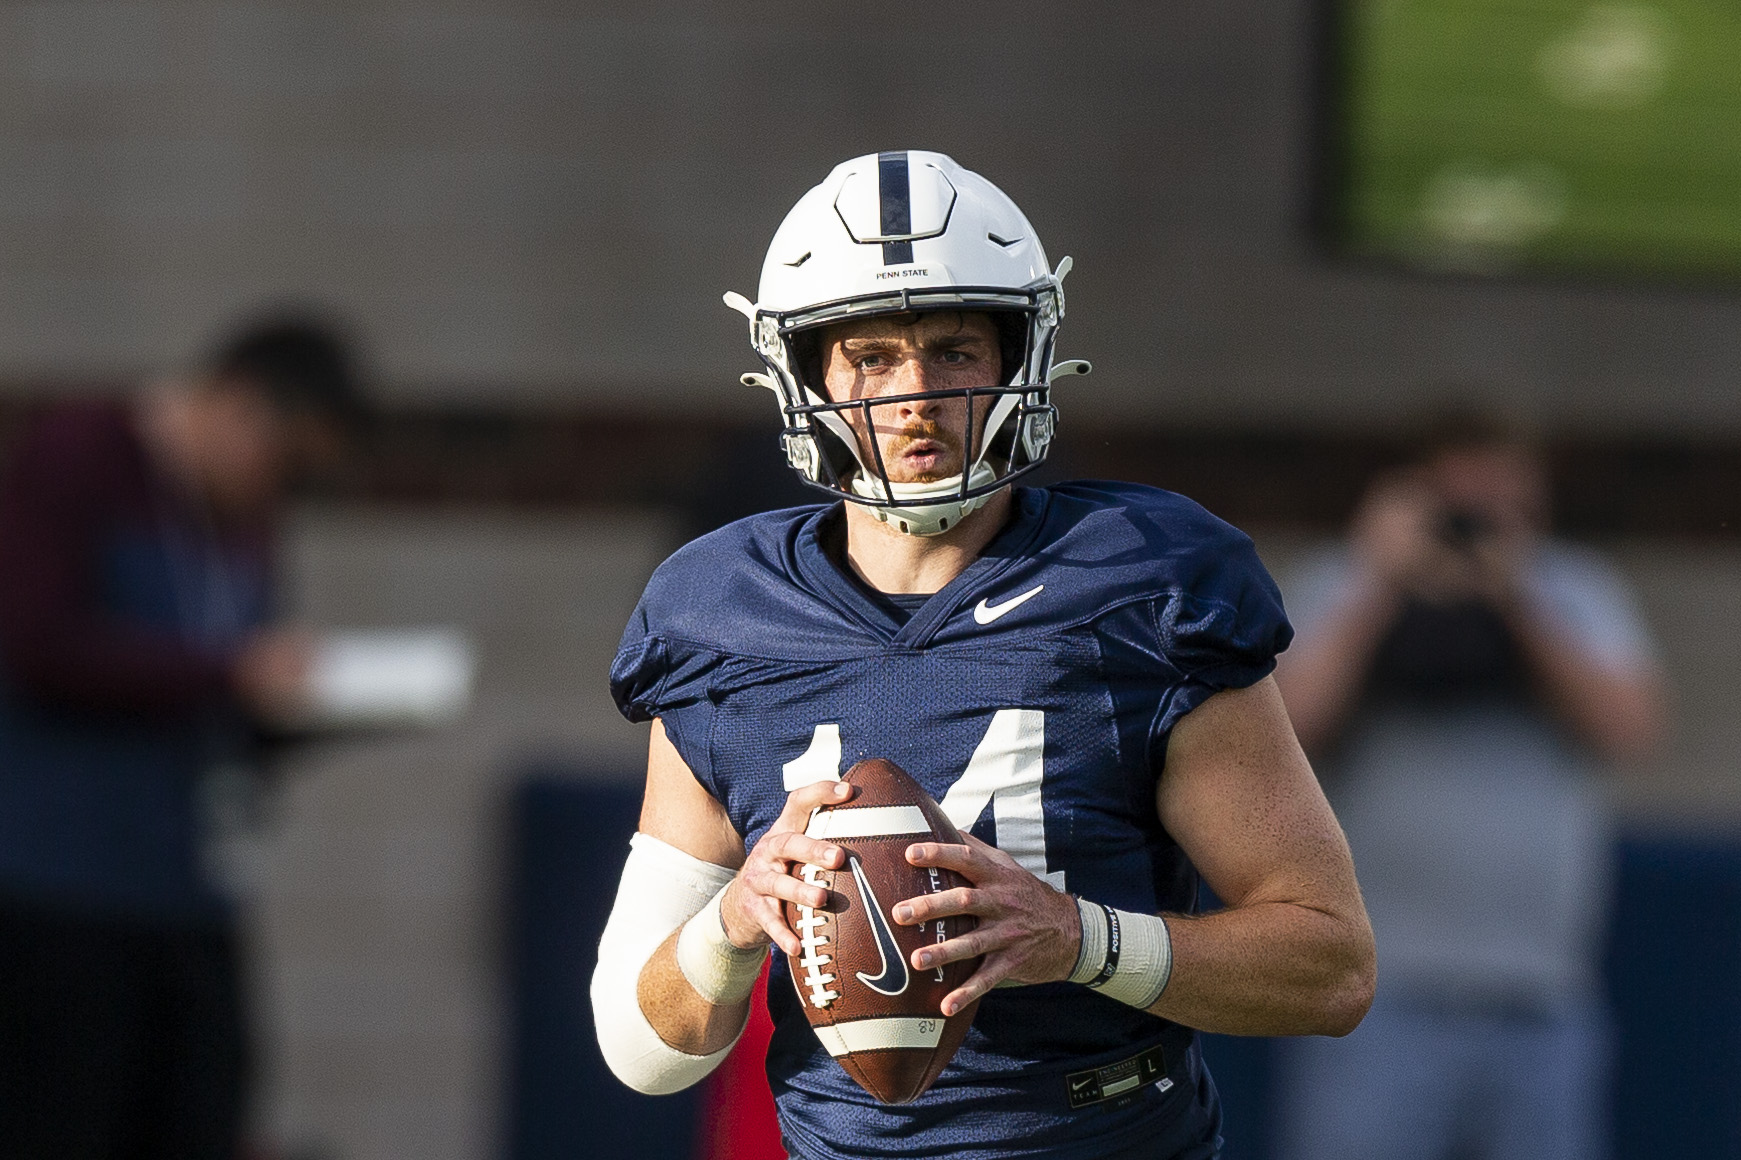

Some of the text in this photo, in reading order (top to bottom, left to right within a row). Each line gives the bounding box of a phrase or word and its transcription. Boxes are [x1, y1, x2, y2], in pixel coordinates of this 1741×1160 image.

[877, 269, 929, 280] PENN STATE
[1147, 1059, 1157, 1073] L
[1073, 1090, 1098, 1100] TEAM
